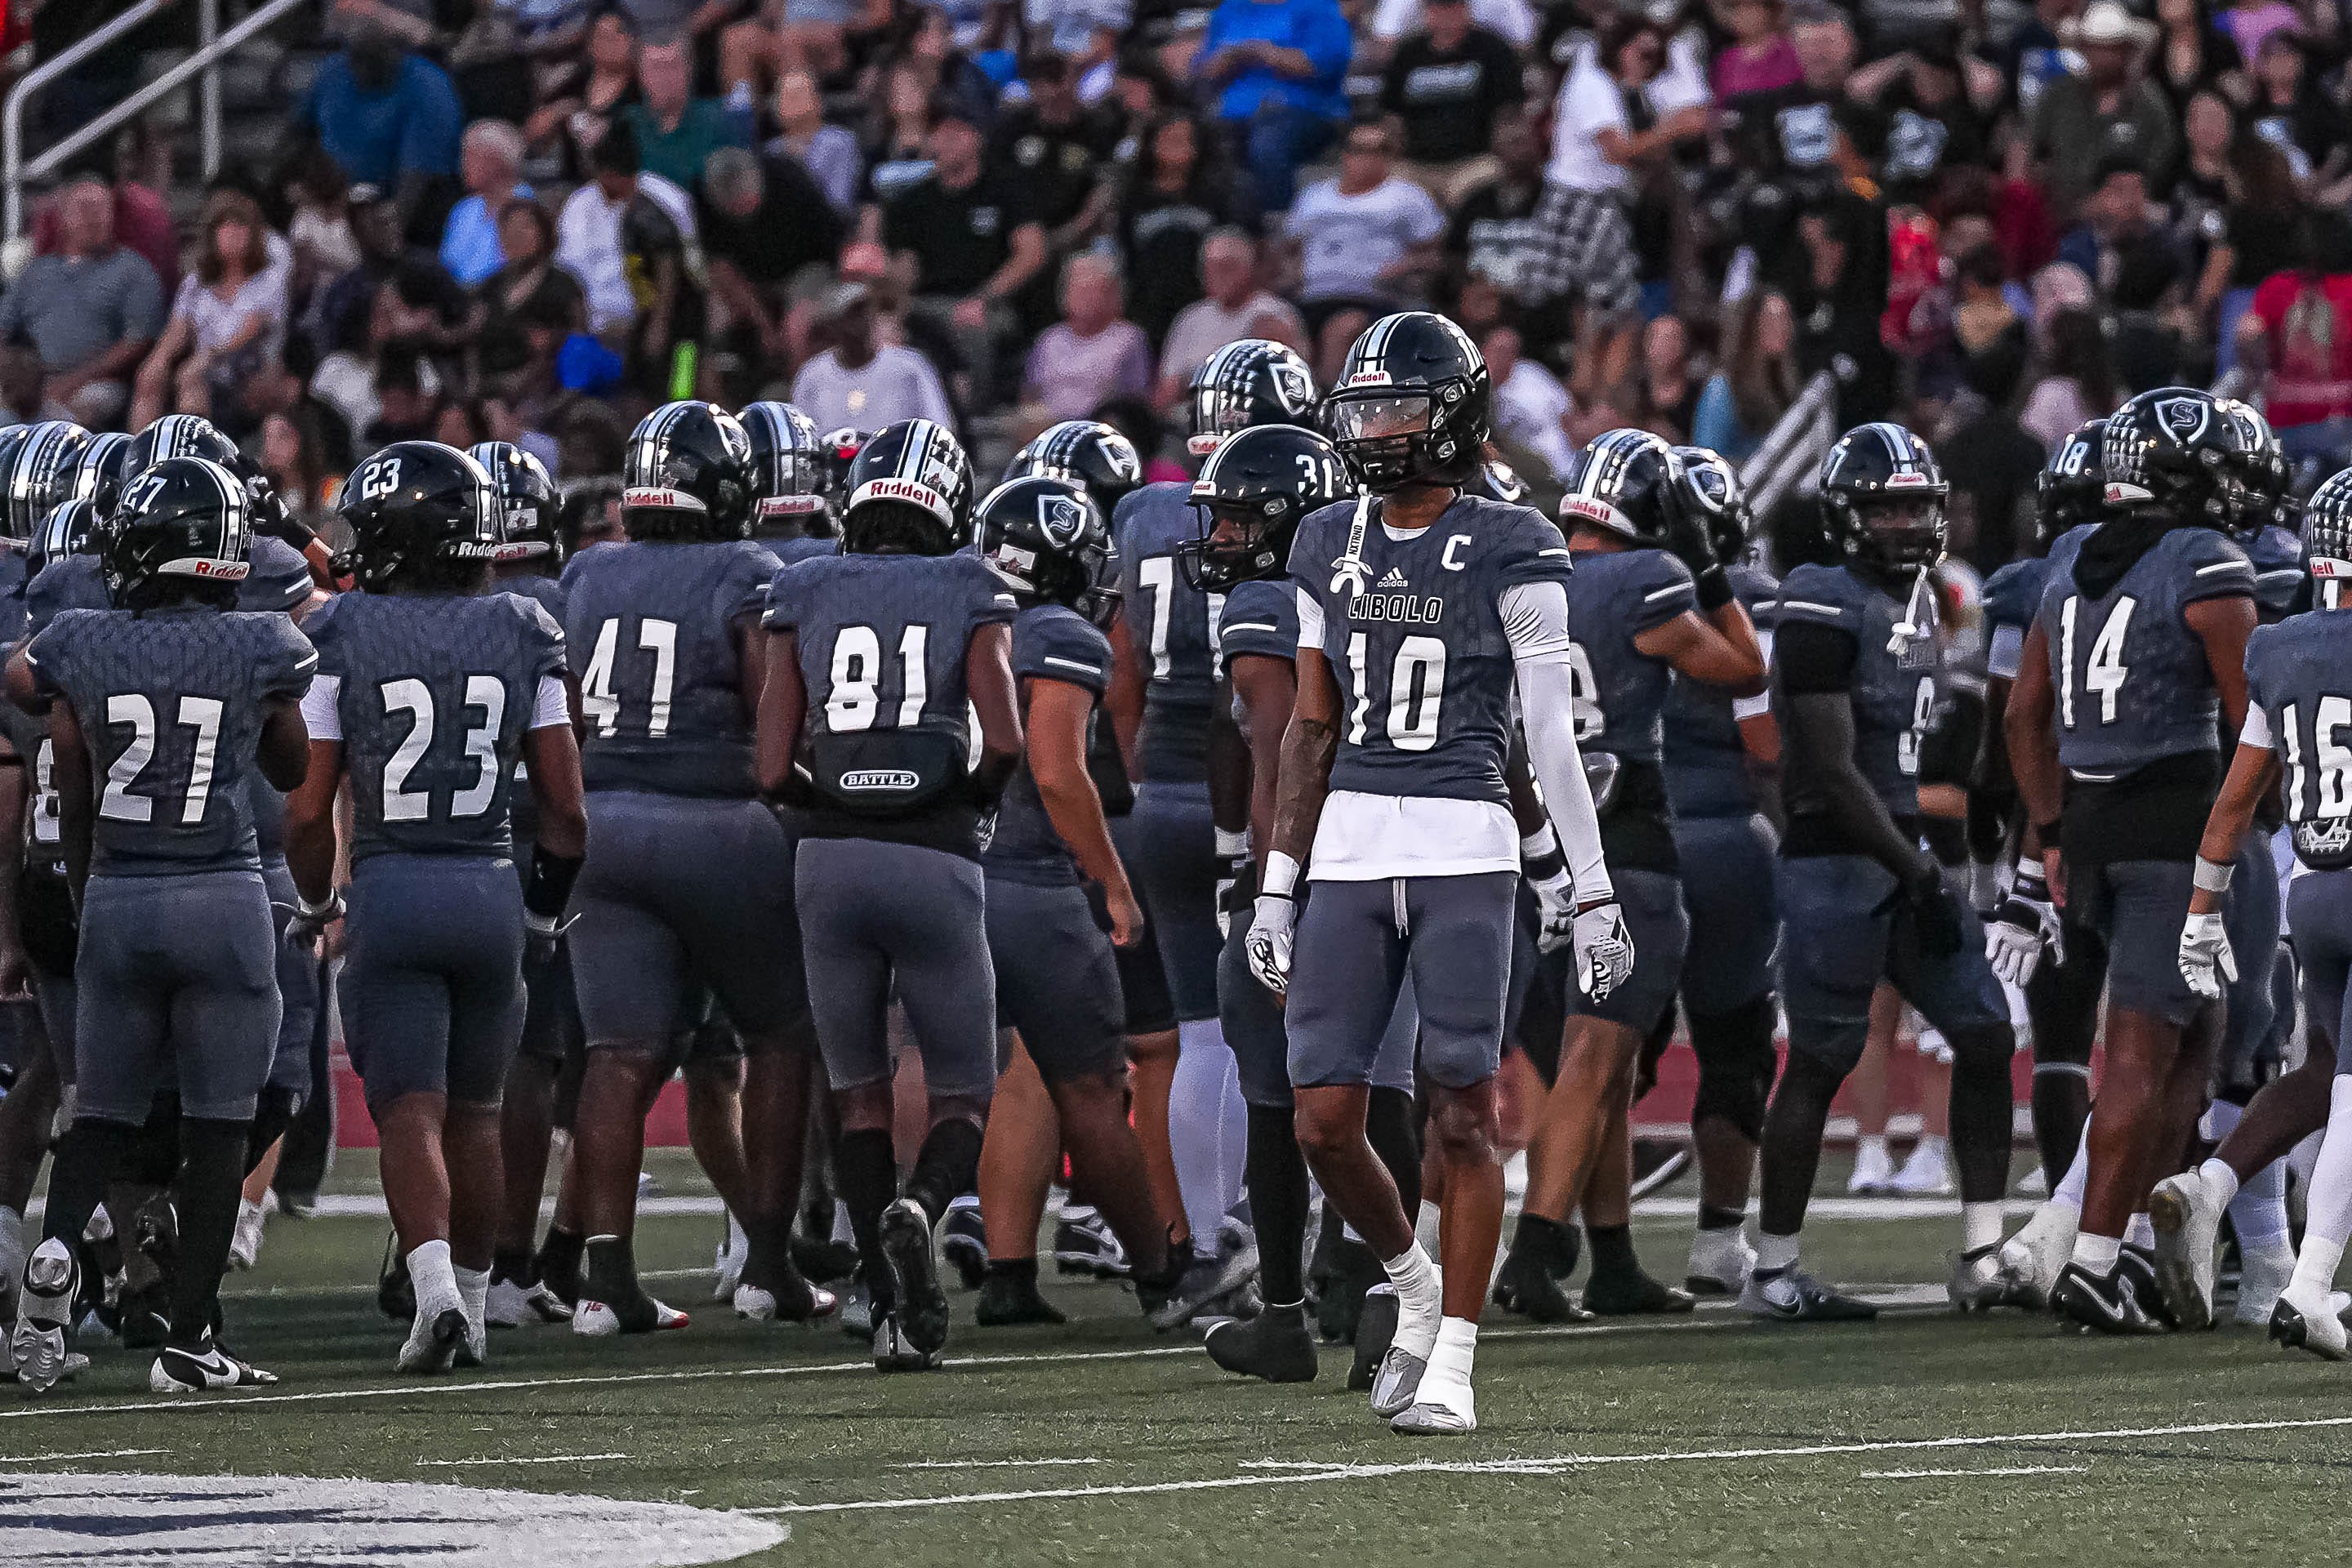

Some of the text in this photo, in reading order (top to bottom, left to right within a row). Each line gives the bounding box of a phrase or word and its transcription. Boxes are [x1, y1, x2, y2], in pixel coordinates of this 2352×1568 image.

[1352, 372, 1385, 383] Riddell
[122, 474, 168, 514] 27
[362, 457, 401, 501] 23
[871, 481, 936, 508] Riddell
[1295, 454, 1333, 498] 31
[1348, 524, 1363, 555] NXTRND
[1441, 533, 1472, 572] C
[1377, 579, 1409, 588] adidas
[581, 617, 678, 738] 47
[824, 625, 927, 733] 81
[2060, 595, 2137, 728] 14
[1346, 632, 1446, 751] 10
[99, 693, 224, 823] 27
[380, 675, 506, 822] 23
[2283, 696, 2352, 822] 16
[847, 773, 912, 786] BATTLE
